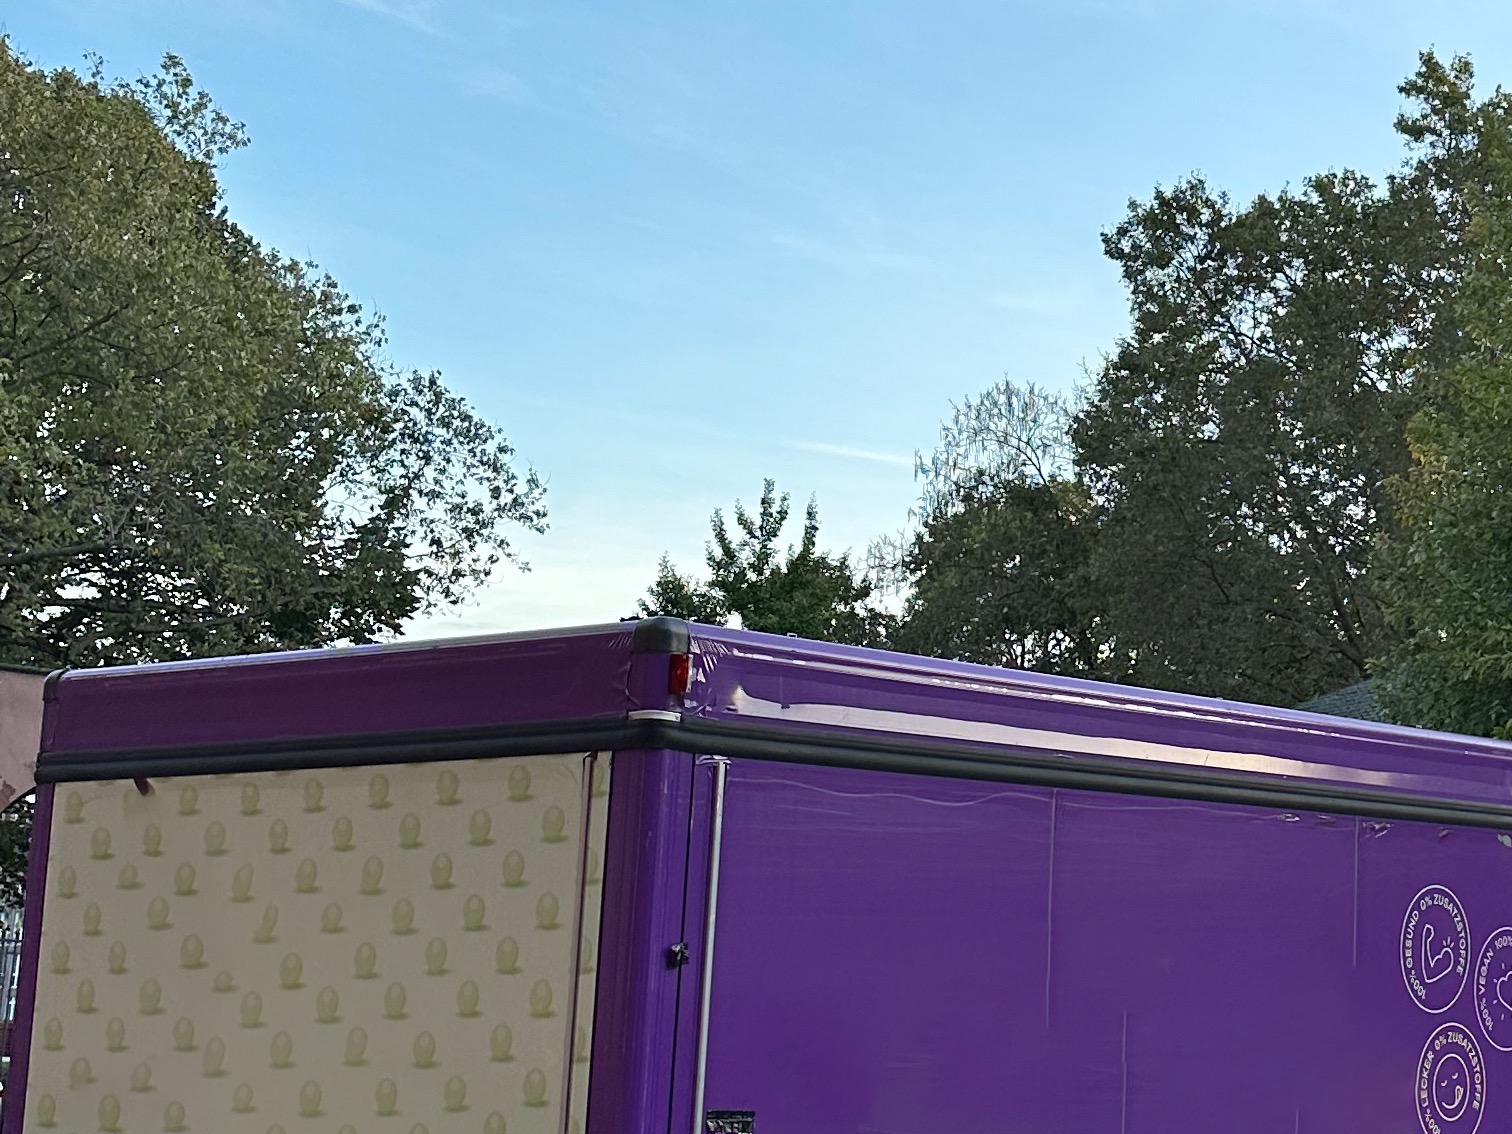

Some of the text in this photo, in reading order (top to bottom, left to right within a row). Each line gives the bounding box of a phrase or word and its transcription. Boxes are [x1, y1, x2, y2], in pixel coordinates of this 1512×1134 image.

[1409, 969, 1426, 999] 100%
[1420, 895, 1433, 911] 0%
[1433, 893, 1466, 977] ZUSATZSTOFFE
[1478, 948, 1494, 995] VEGAN
[1480, 998, 1494, 1030] 100%
[1421, 1050, 1435, 1107] LECKER
[1434, 1034, 1447, 1051] 0%
[1447, 1032, 1481, 1111] ZUSATZSTOFFE
